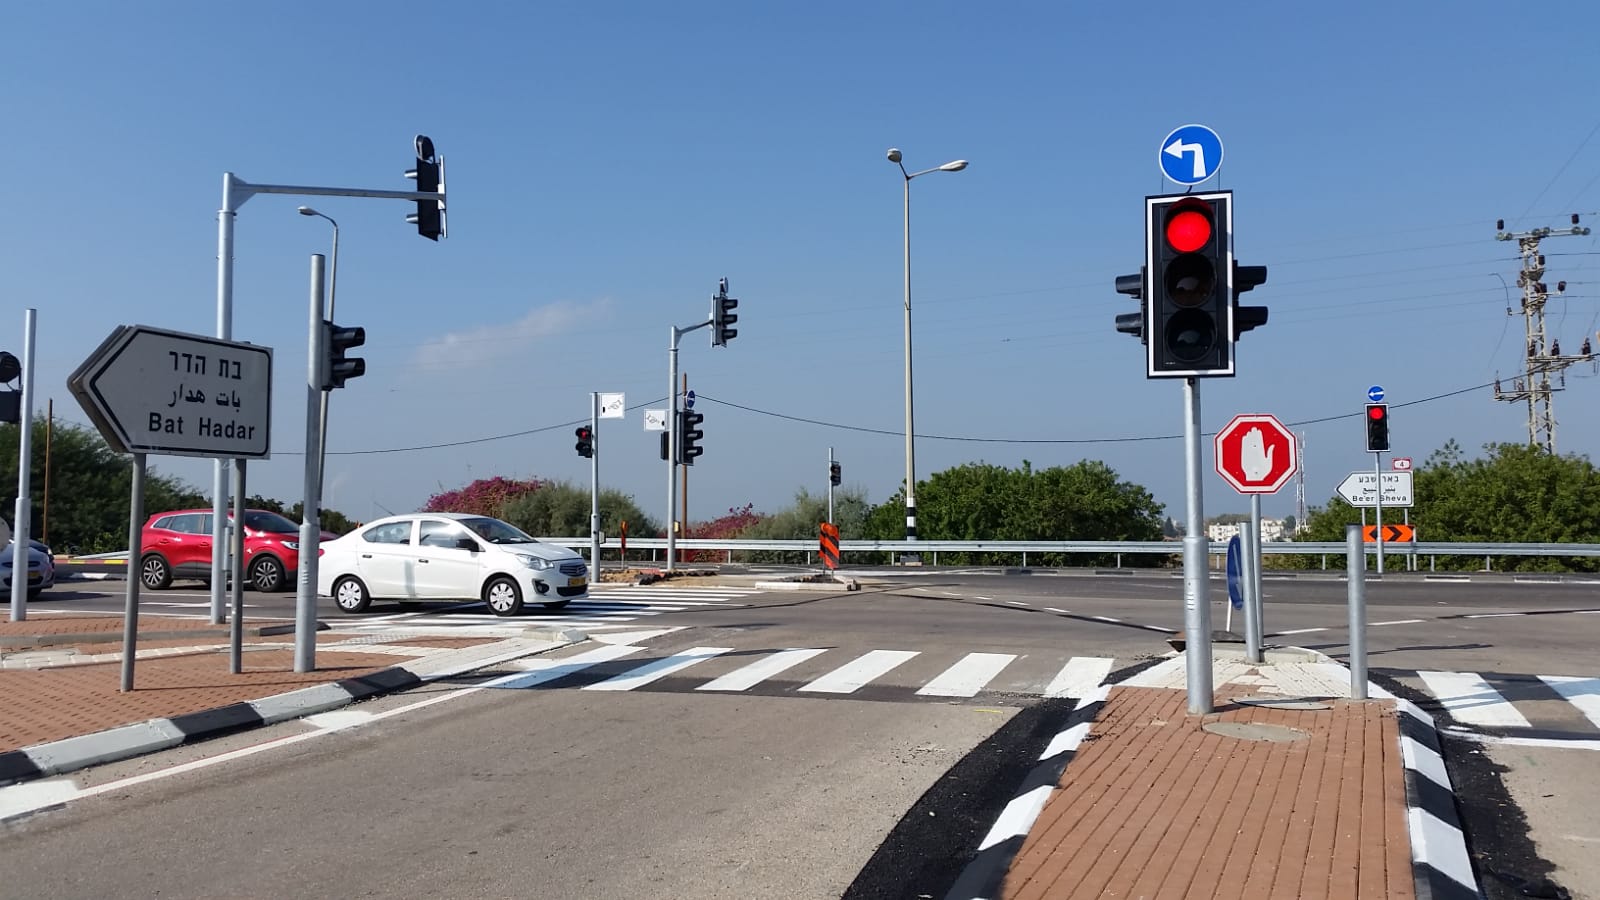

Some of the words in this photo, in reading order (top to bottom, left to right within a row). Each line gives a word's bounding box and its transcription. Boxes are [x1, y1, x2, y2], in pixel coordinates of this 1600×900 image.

[168, 351, 206, 375] הדר
[218, 358, 242, 380] בת
[167, 383, 206, 408] هدار
[215, 389, 242, 413] بات
[148, 411, 184, 435] Bat
[198, 416, 255, 440] Hadar
[1359, 475, 1377, 483] שבע
[1382, 475, 1399, 483] באר
